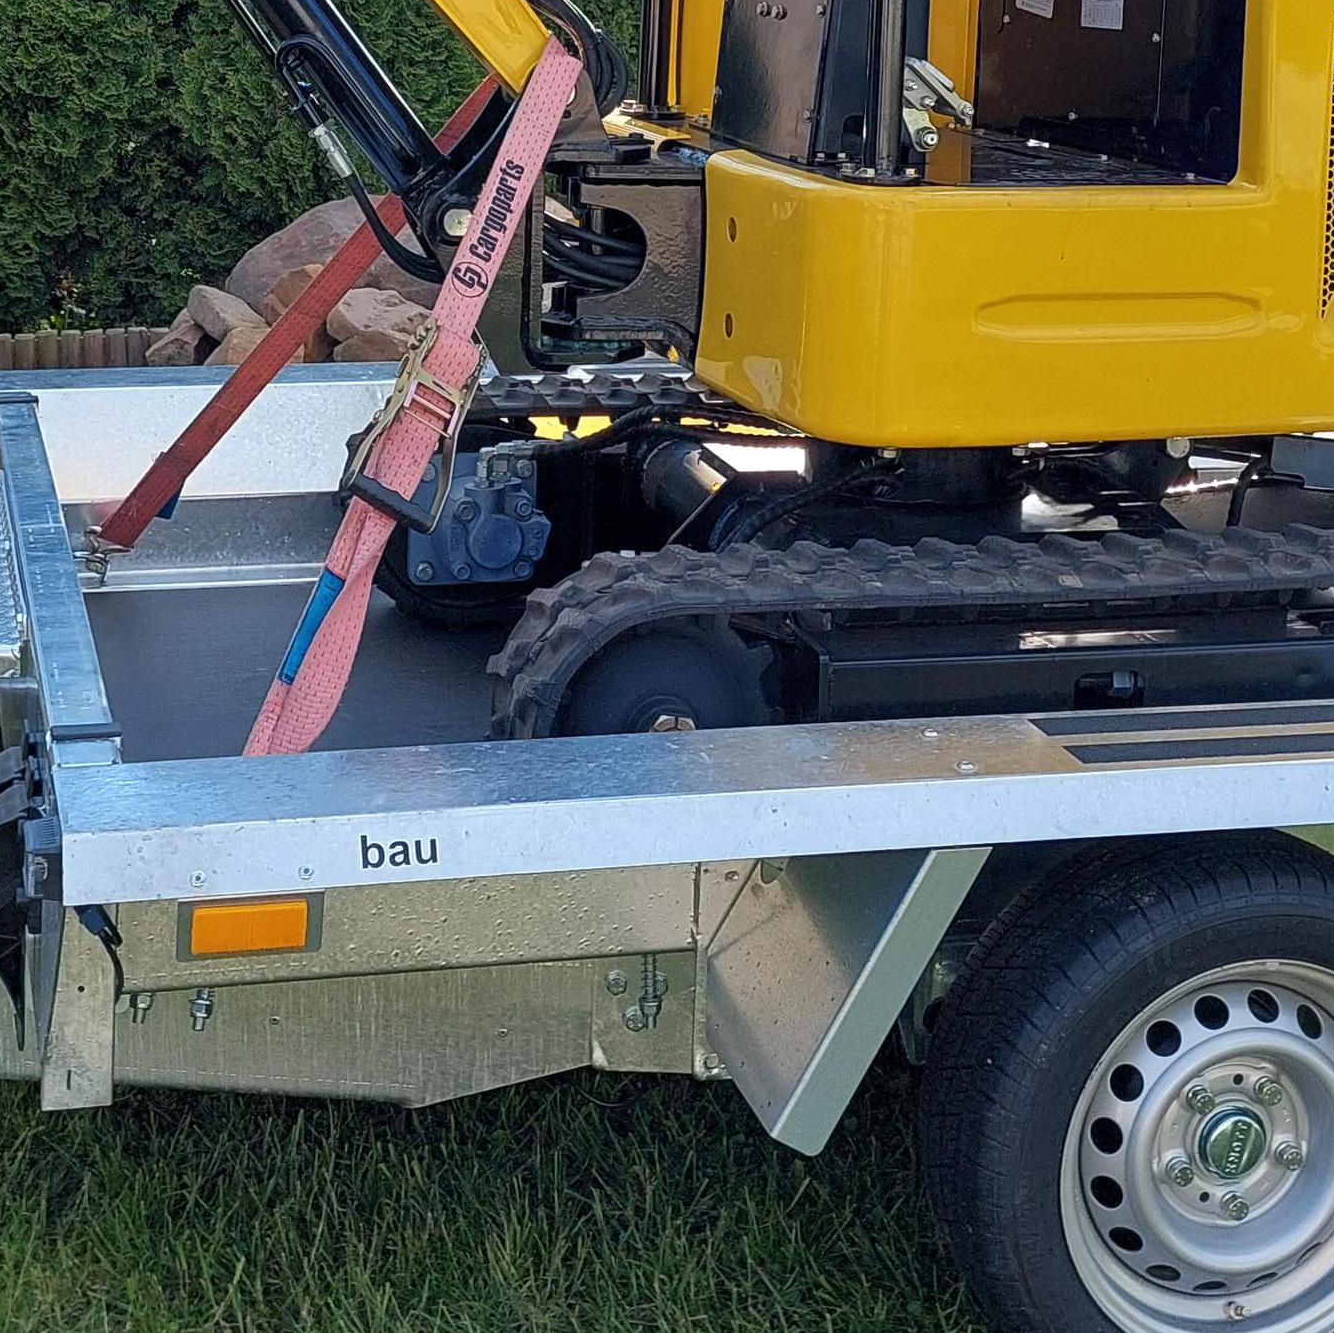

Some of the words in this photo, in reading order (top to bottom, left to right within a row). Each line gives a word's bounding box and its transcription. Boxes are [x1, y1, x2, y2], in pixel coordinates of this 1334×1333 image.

[468, 158, 525, 263] Cargoparts
[359, 834, 439, 870] bau
[1225, 1122, 1248, 1174] KNOTT
